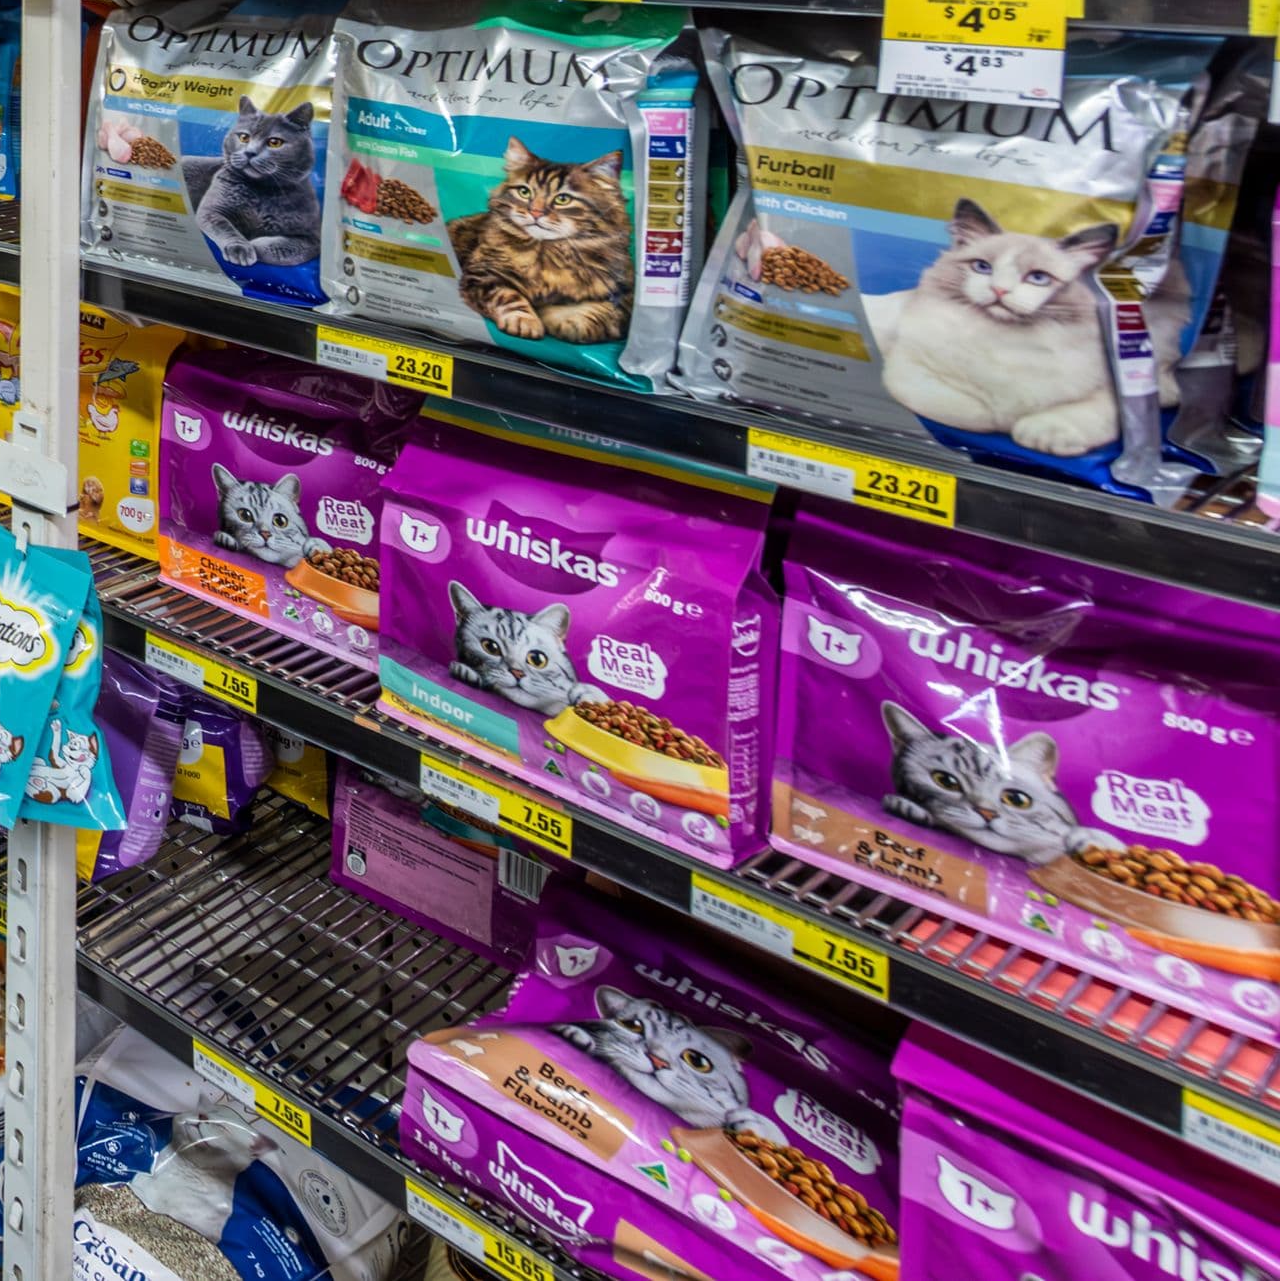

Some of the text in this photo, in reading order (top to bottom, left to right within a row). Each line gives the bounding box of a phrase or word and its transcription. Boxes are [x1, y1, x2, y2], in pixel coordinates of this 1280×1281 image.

[358, 39, 612, 92] OPTIMUM
[184, 80, 233, 98] Weight
[358, 110, 391, 129] Adult
[732, 63, 1120, 152] OPTIMUM
[756, 154, 834, 182] Furball
[784, 200, 846, 222] Chicken
[395, 354, 442, 382] 23.20
[223, 411, 334, 456] whiskas
[868, 470, 940, 504] 23.20
[325, 497, 363, 517] Real
[326, 513, 366, 530] Meat
[465, 517, 619, 588] whiskas
[598, 637, 652, 664] Real
[221, 671, 251, 696] 7.55
[601, 656, 656, 681] Meat
[908, 626, 1121, 710] whiskas
[1109, 773, 1188, 805] Real
[522, 806, 562, 837] 7.55
[1111, 798, 1192, 824] Meat
[875, 830, 926, 861] Beef
[824, 940, 876, 979] 7.55
[635, 964, 832, 1073] whiskas
[273, 1097, 304, 1129] 7.55
[503, 1077, 588, 1140] Flavours
[489, 1160, 592, 1244] whiskas
[495, 1242, 544, 1281] 15.65
